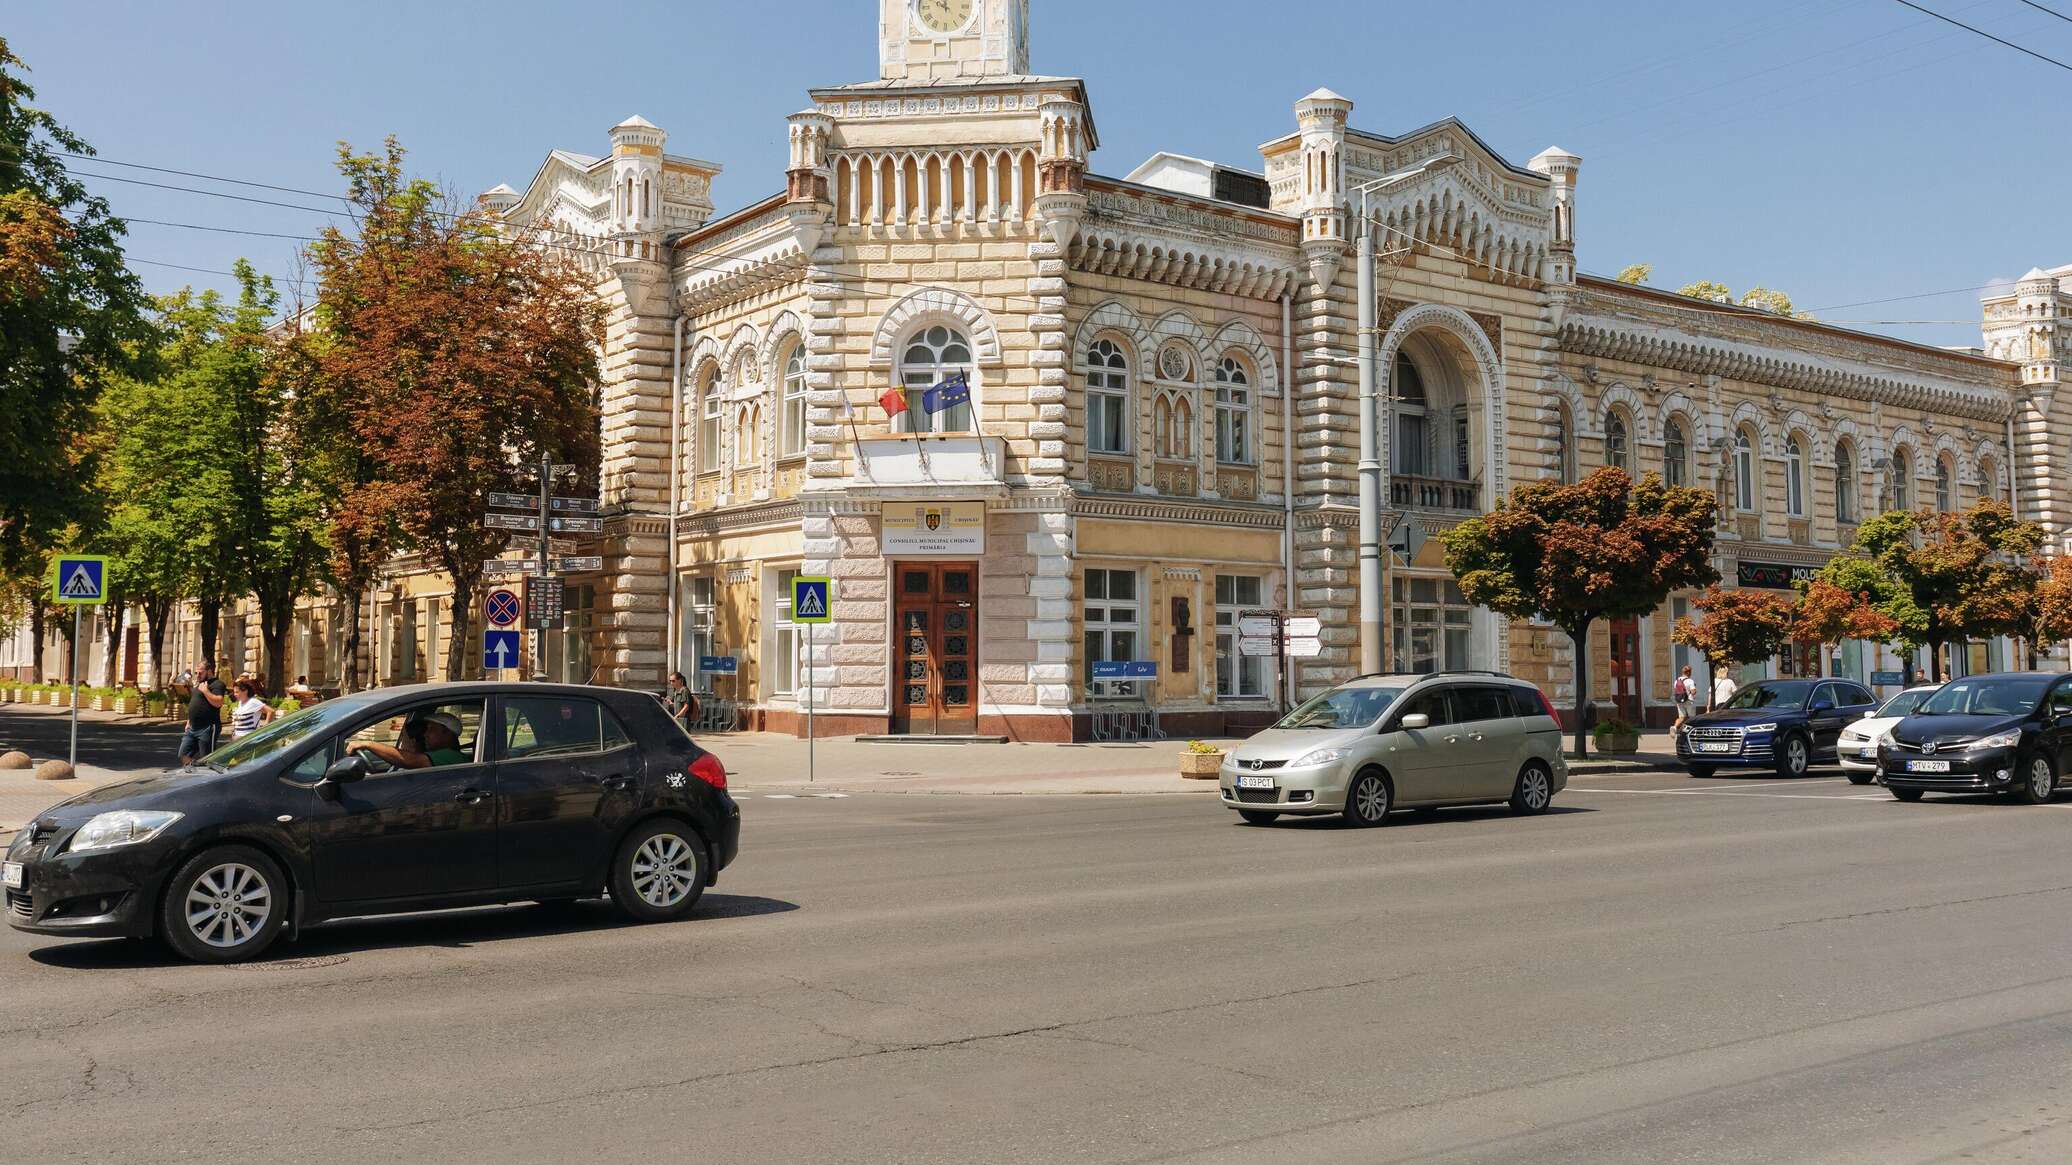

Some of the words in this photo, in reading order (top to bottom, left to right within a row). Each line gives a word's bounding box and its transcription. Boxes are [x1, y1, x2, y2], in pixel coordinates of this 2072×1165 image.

[1932, 762, 1945, 770] 279
[1249, 778, 1257, 787] 03
[1257, 778, 1271, 787] PCT
